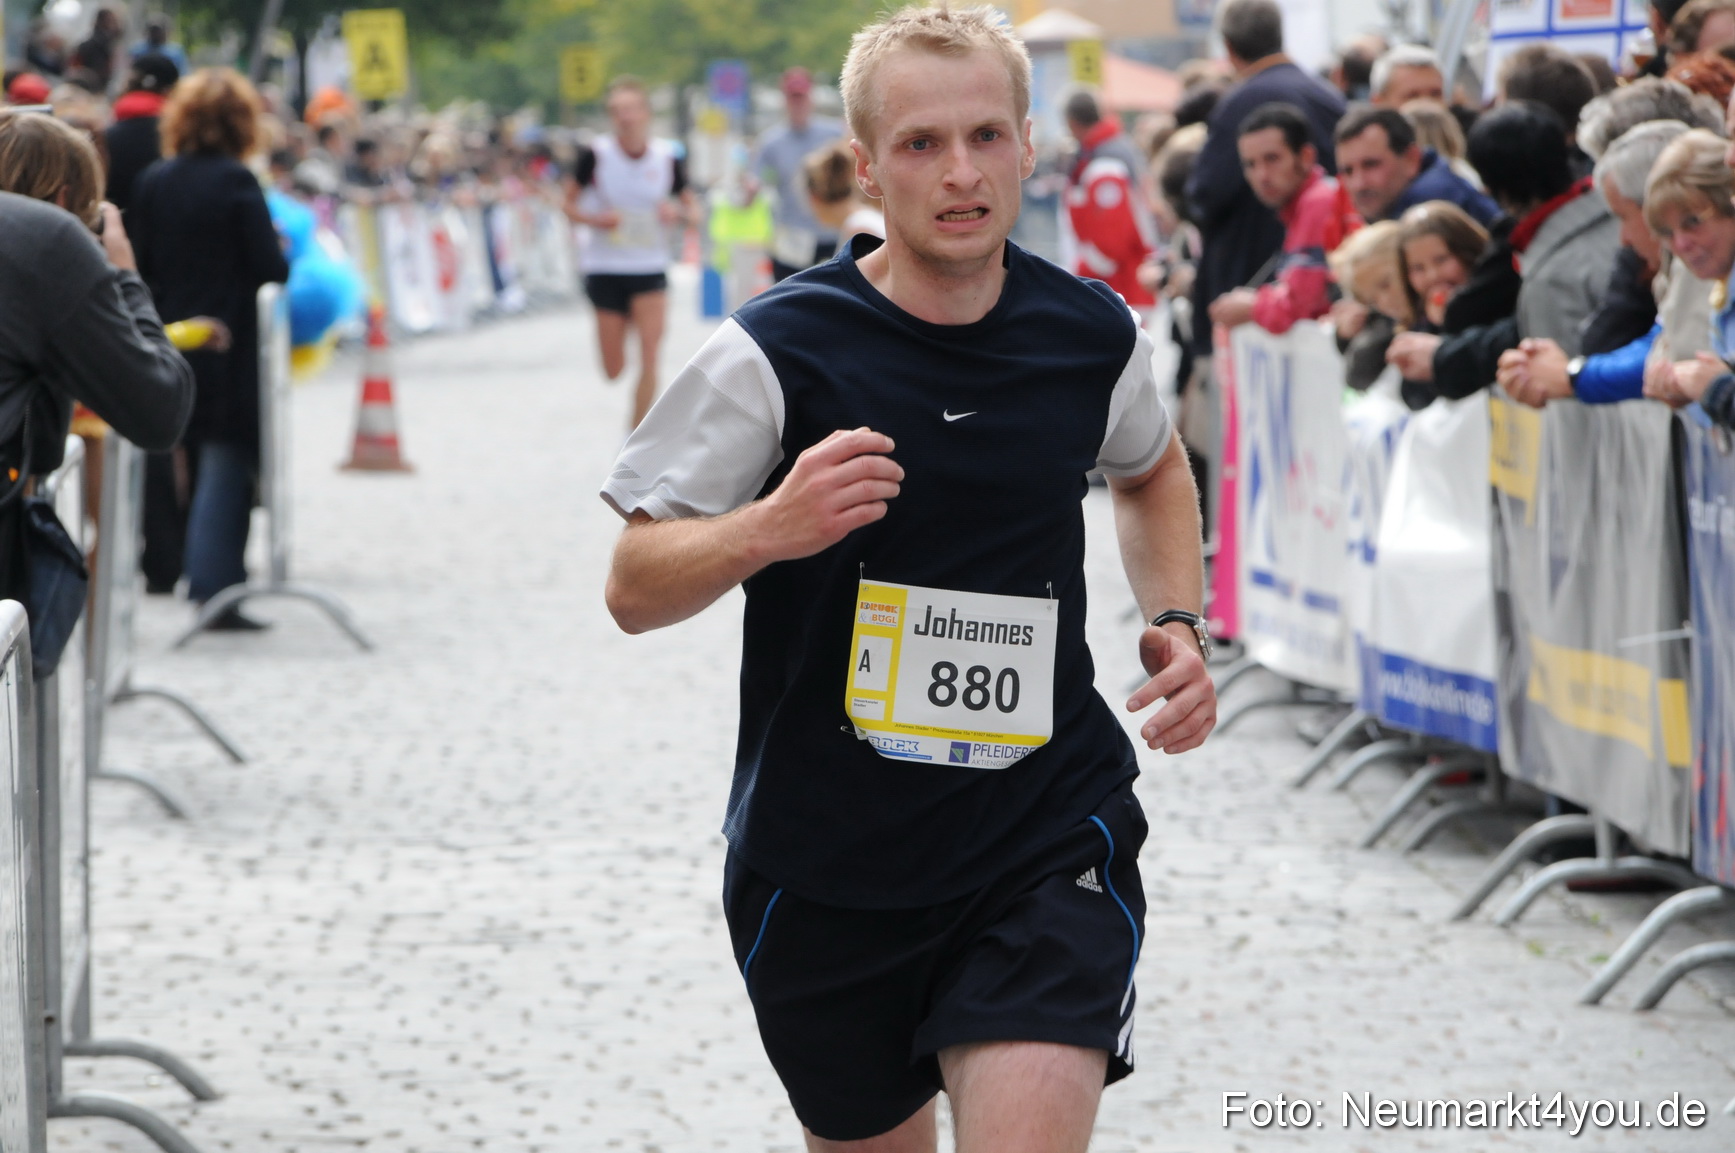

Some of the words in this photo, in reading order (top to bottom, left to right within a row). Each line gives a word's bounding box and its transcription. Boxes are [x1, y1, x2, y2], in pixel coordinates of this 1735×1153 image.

[914, 605, 1033, 646] Johannes
[858, 649, 871, 673] A
[928, 661, 1020, 713] 880
[1076, 878, 1103, 893] adidas
